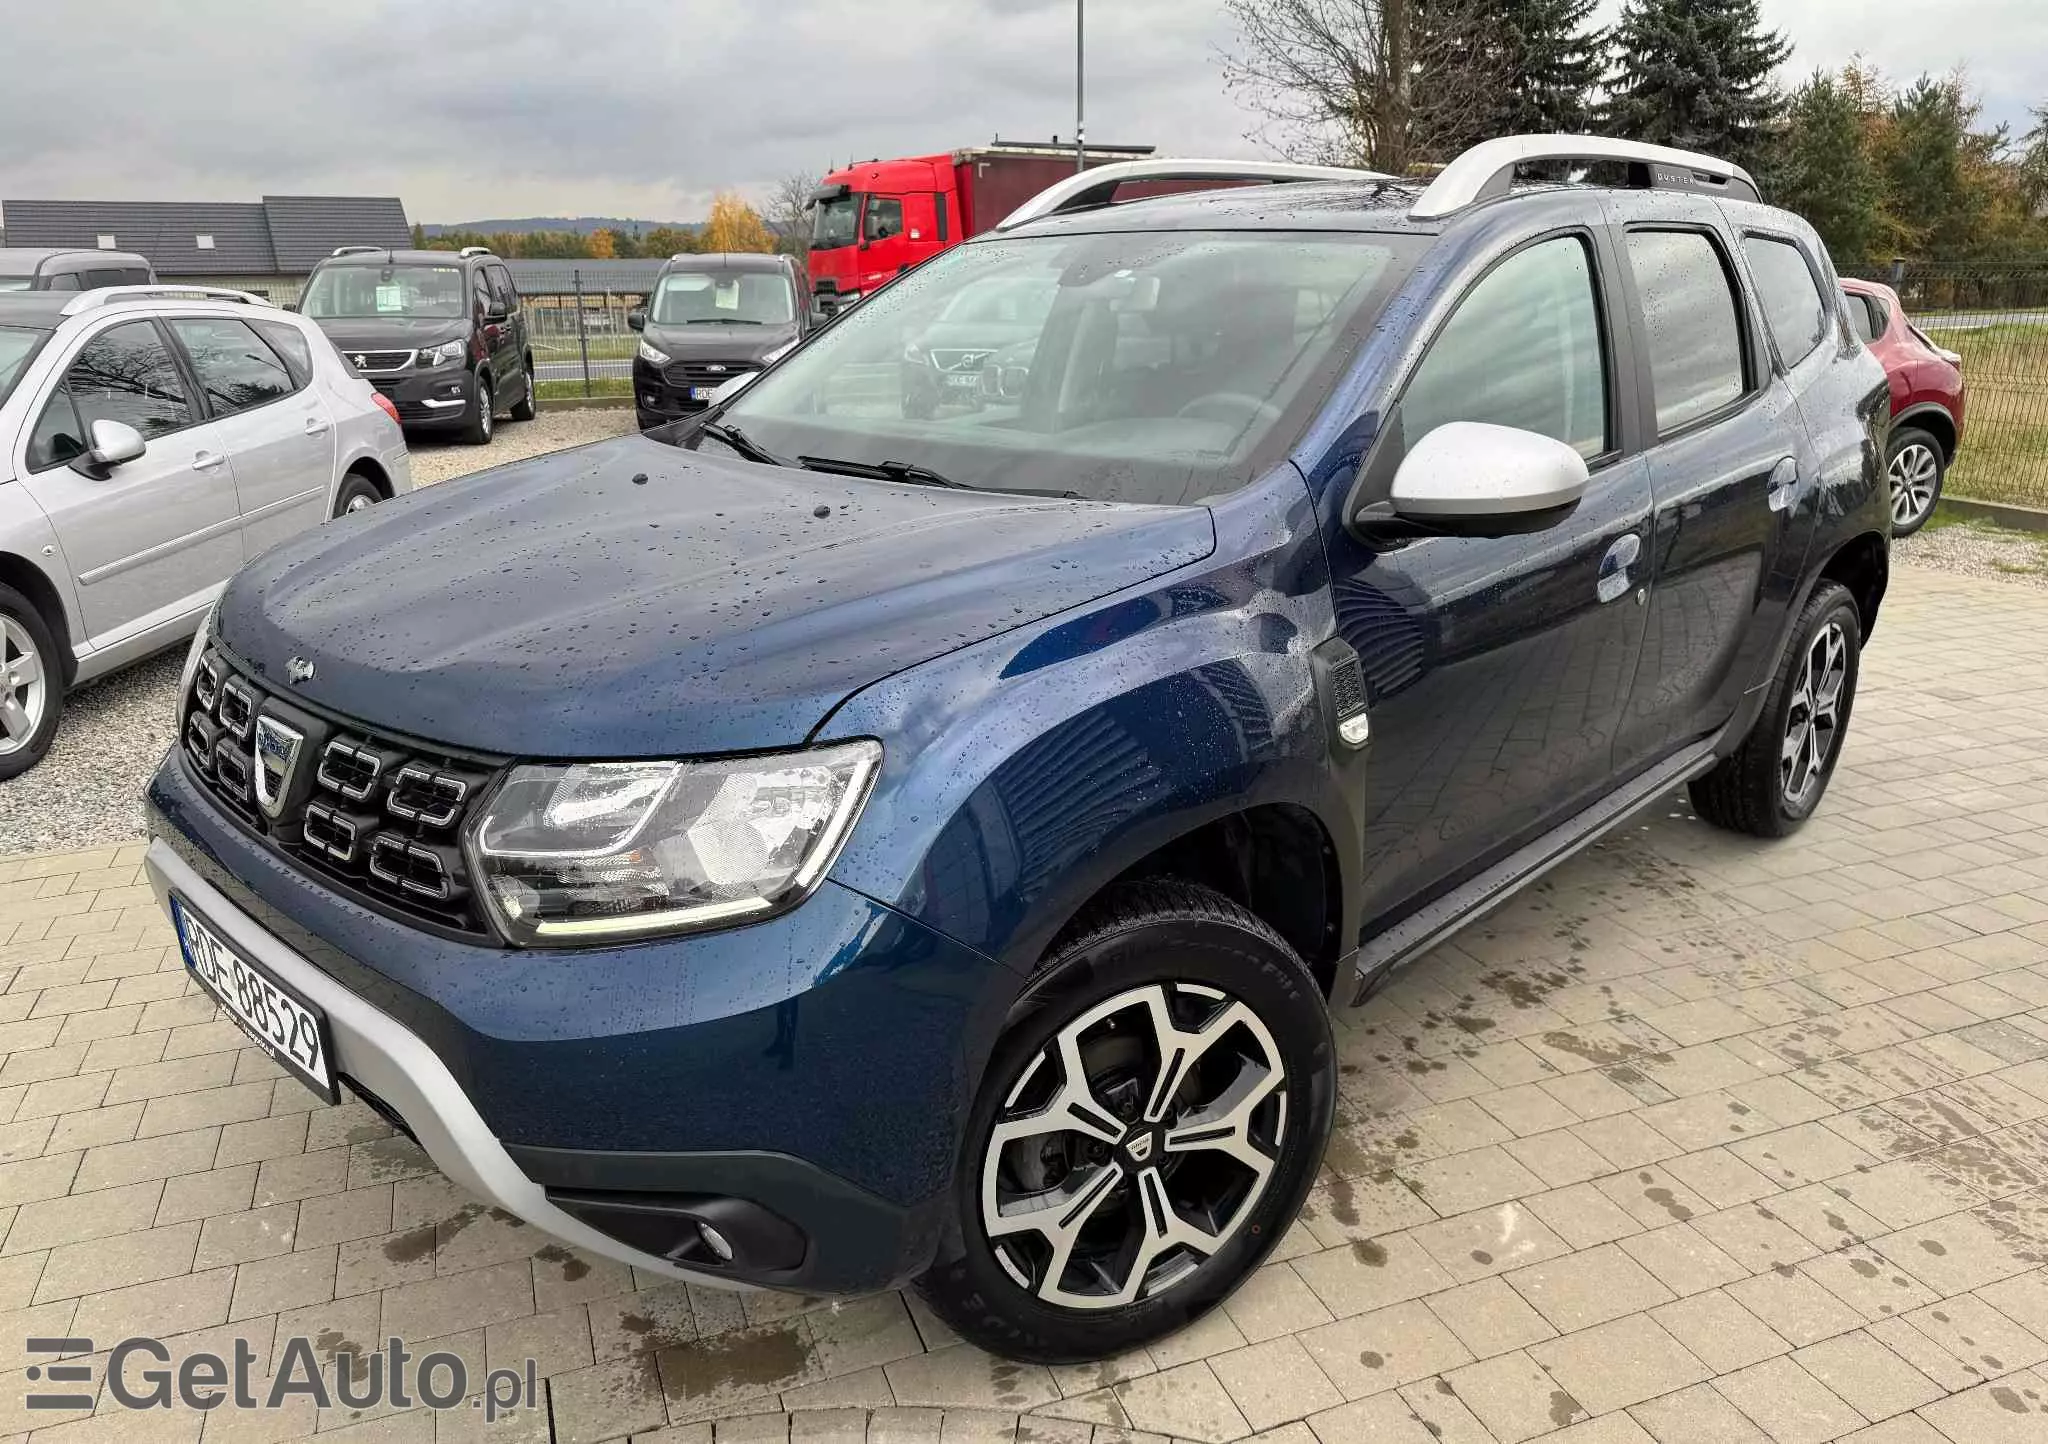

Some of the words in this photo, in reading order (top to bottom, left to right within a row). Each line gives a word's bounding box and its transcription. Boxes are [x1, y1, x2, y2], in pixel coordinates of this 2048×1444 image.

[1657, 173, 1695, 185] DUSTER
[184, 912, 233, 1002] RDE
[233, 959, 320, 1071] 88529
